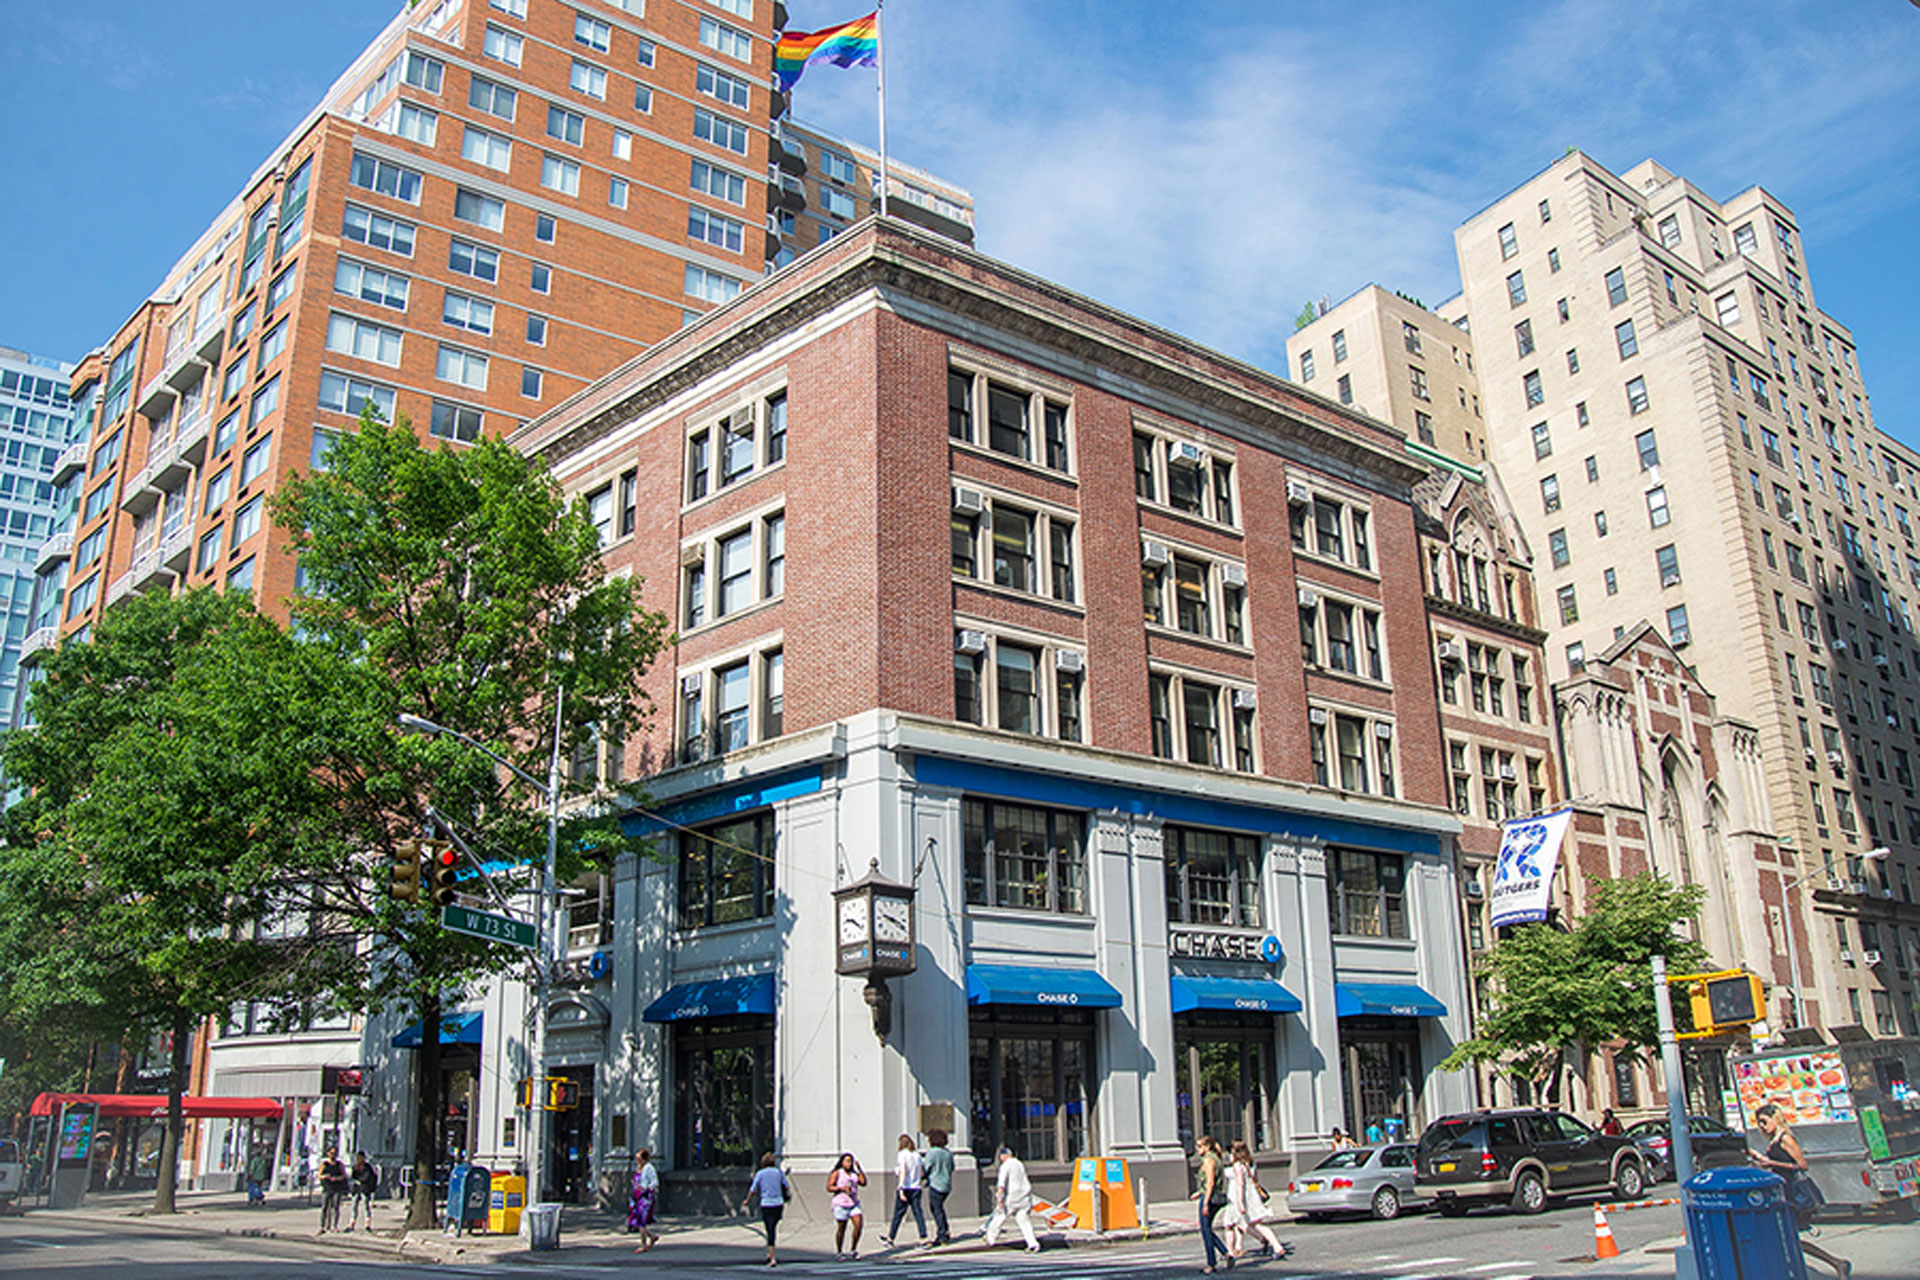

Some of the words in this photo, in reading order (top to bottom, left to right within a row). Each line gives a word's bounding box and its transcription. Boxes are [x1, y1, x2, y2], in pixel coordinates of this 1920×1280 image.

[1493, 880, 1540, 898] RUTGERS
[466, 913, 479, 930] W
[484, 916, 500, 936] 73
[503, 922, 517, 940] St
[1171, 932, 1263, 960] CHASE
[1037, 993, 1068, 1003] CHASE
[1235, 999, 1260, 1008] CHASE
